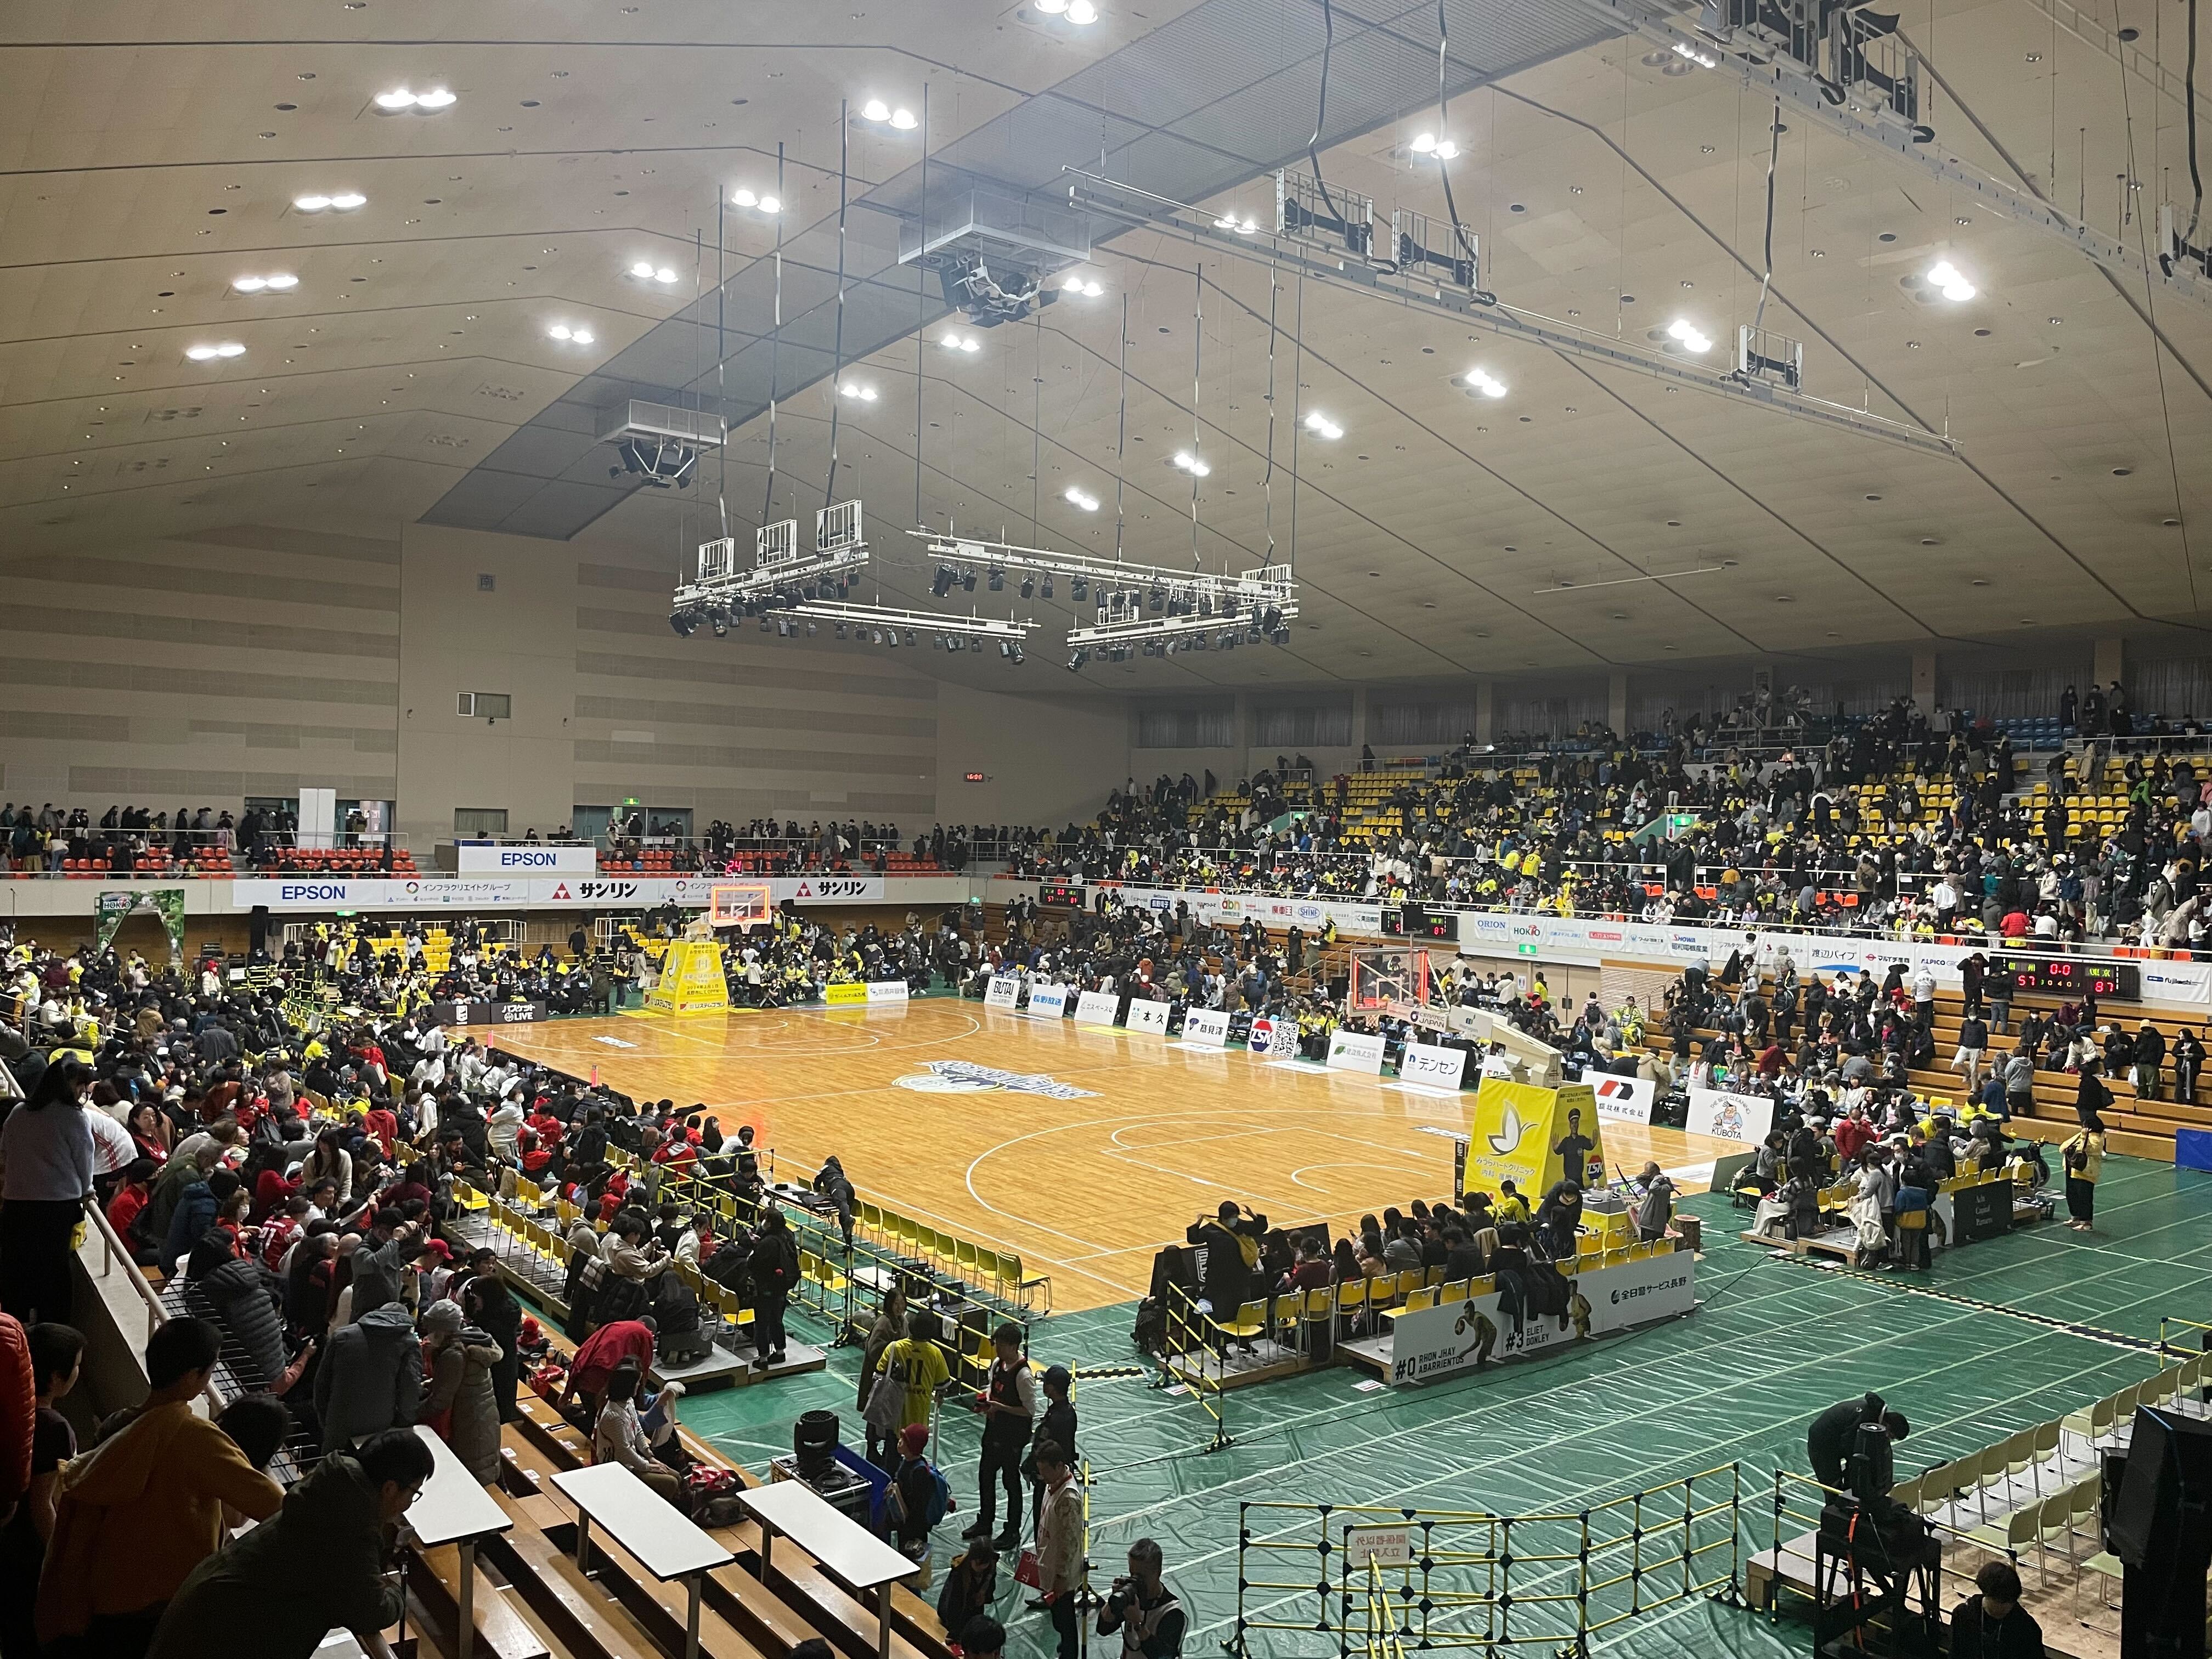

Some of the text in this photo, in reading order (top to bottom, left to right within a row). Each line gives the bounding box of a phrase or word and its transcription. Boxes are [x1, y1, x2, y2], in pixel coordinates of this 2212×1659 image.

[501, 853, 556, 866] EPSON
[727, 860, 742, 872] 24
[282, 885, 346, 900] EPSON
[423, 883, 511, 891] インフラクリエイトグループ
[579, 883, 638, 899] サンリン
[818, 882, 867, 896] サンリン
[103, 896, 132, 910] HOKTO
[1222, 897, 1240, 911] abn
[1477, 920, 1505, 929] ORION
[1514, 924, 1541, 936] HOKTO
[1673, 934, 1696, 943] SHOWA
[1812, 948, 1857, 961] 渡辺パイプ
[2050, 963, 2071, 976] 0.0
[994, 980, 1015, 996] BUTAI
[2018, 974, 2036, 986] 57
[2095, 980, 2114, 992] 87
[1033, 995, 1062, 1006] 長野放送
[502, 1003, 536, 1013] バスケット
[514, 1012, 533, 1020] LIVE
[1419, 1018, 1444, 1028] JAPAN
[1251, 1030, 1273, 1044] TSK
[1419, 1058, 1459, 1075] テンセン
[1711, 1127, 1741, 1139] KUBOTA
[1476, 1156, 1535, 1176] みうらハートクリニック
[1587, 1160, 1603, 1175] TSK
[1621, 1277, 1687, 1300] 全日警サービス長野
[1527, 1325, 1544, 1336] ELIET
[1505, 1331, 1523, 1351] #3
[1526, 1333, 1549, 1346] DONLEY
[1419, 1346, 1456, 1364] RHON JHAY
[1395, 1357, 1415, 1380] #0
[1418, 1356, 1464, 1374] ABARRIENTOS
